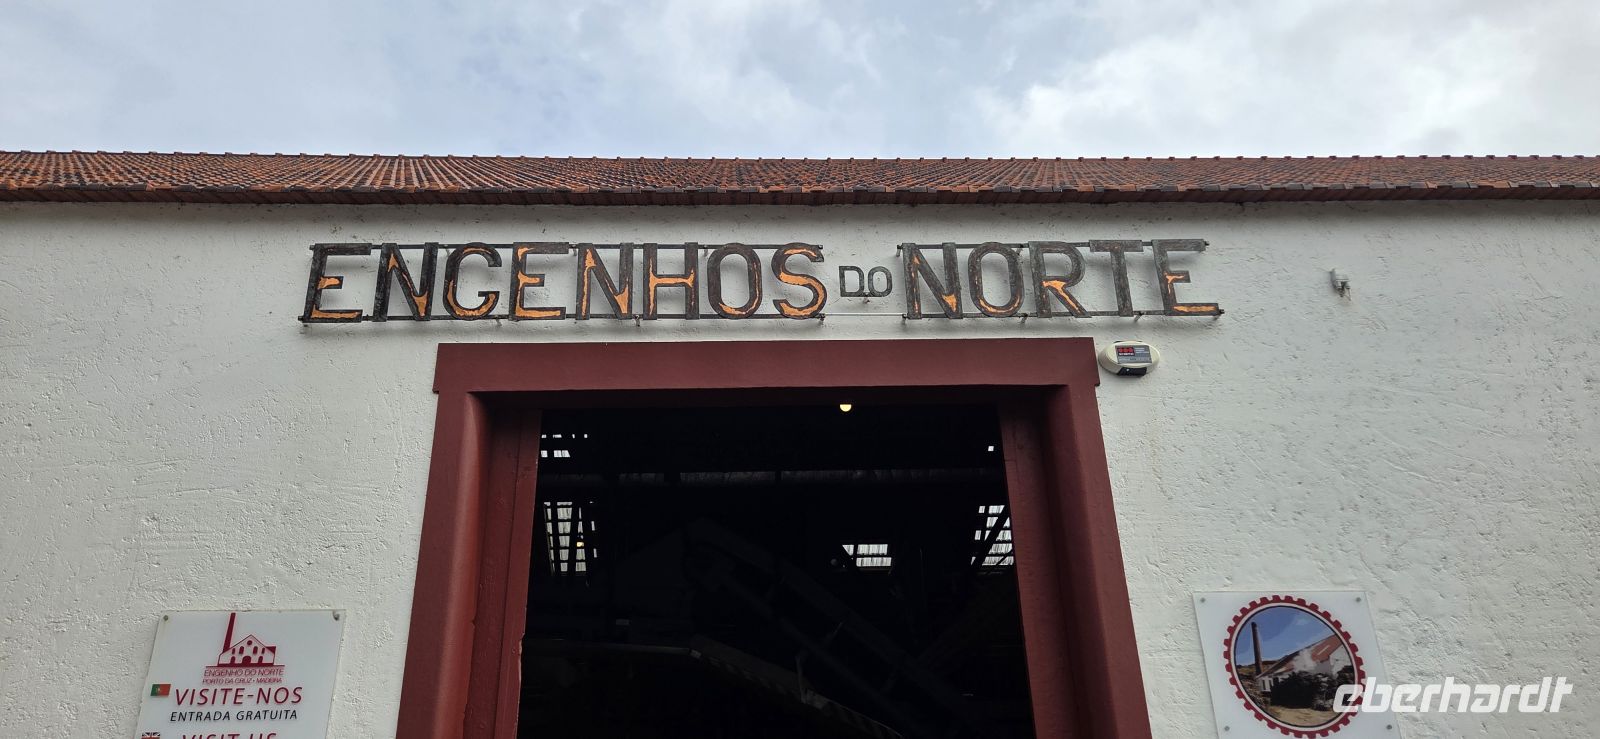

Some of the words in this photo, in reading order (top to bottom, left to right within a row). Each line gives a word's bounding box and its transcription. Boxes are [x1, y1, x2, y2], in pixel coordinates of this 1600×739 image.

[302, 242, 827, 322] ENGENHOS
[838, 265, 893, 298] DO
[902, 238, 1220, 320] NORTE
[203, 669, 243, 677] ENGENHO
[244, 668, 257, 676] DO
[257, 667, 285, 676] NORTE
[175, 686, 303, 706] VISITE-NOS
[170, 711, 231, 722] ENTRADA
[236, 709, 298, 721] GRATUITA
